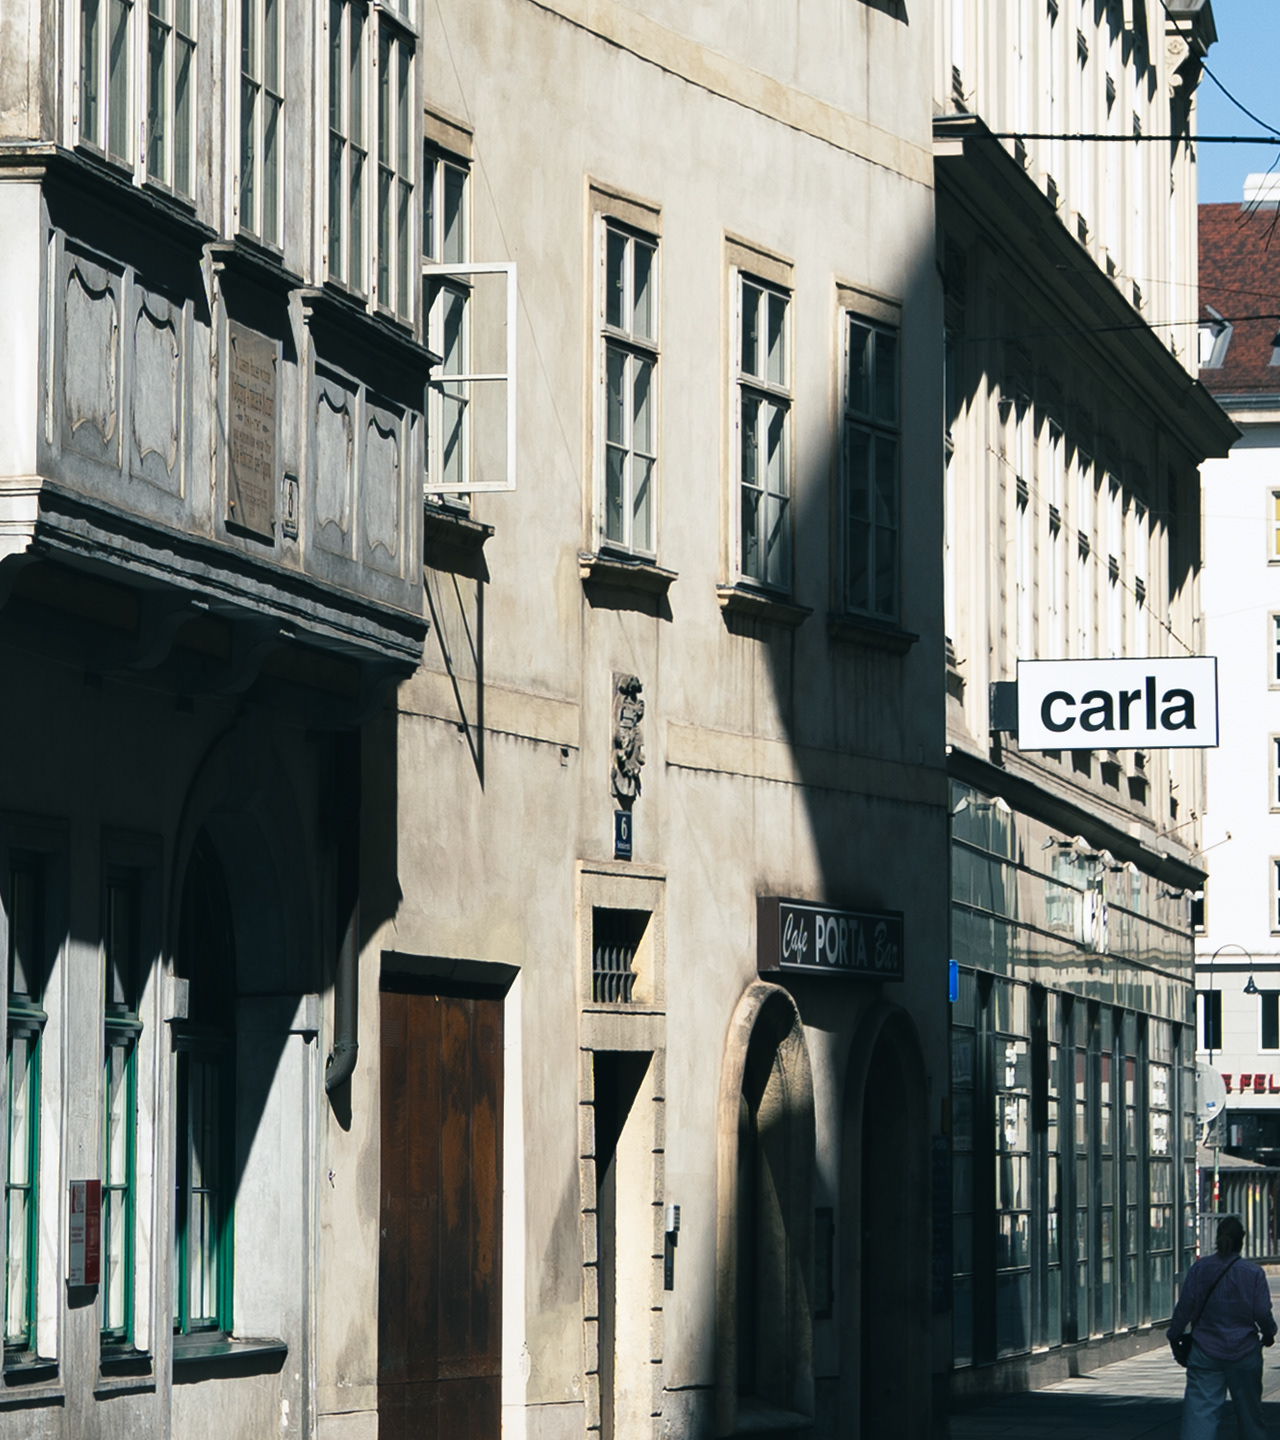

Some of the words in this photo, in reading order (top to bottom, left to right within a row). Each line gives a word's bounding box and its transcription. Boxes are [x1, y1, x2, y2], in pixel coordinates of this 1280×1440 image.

[288, 481, 294, 518] 8
[1041, 676, 1197, 732] carla
[621, 816, 628, 840] 6
[782, 912, 809, 964] Cafe
[815, 914, 868, 967] PORTA
[874, 920, 899, 970] Bar
